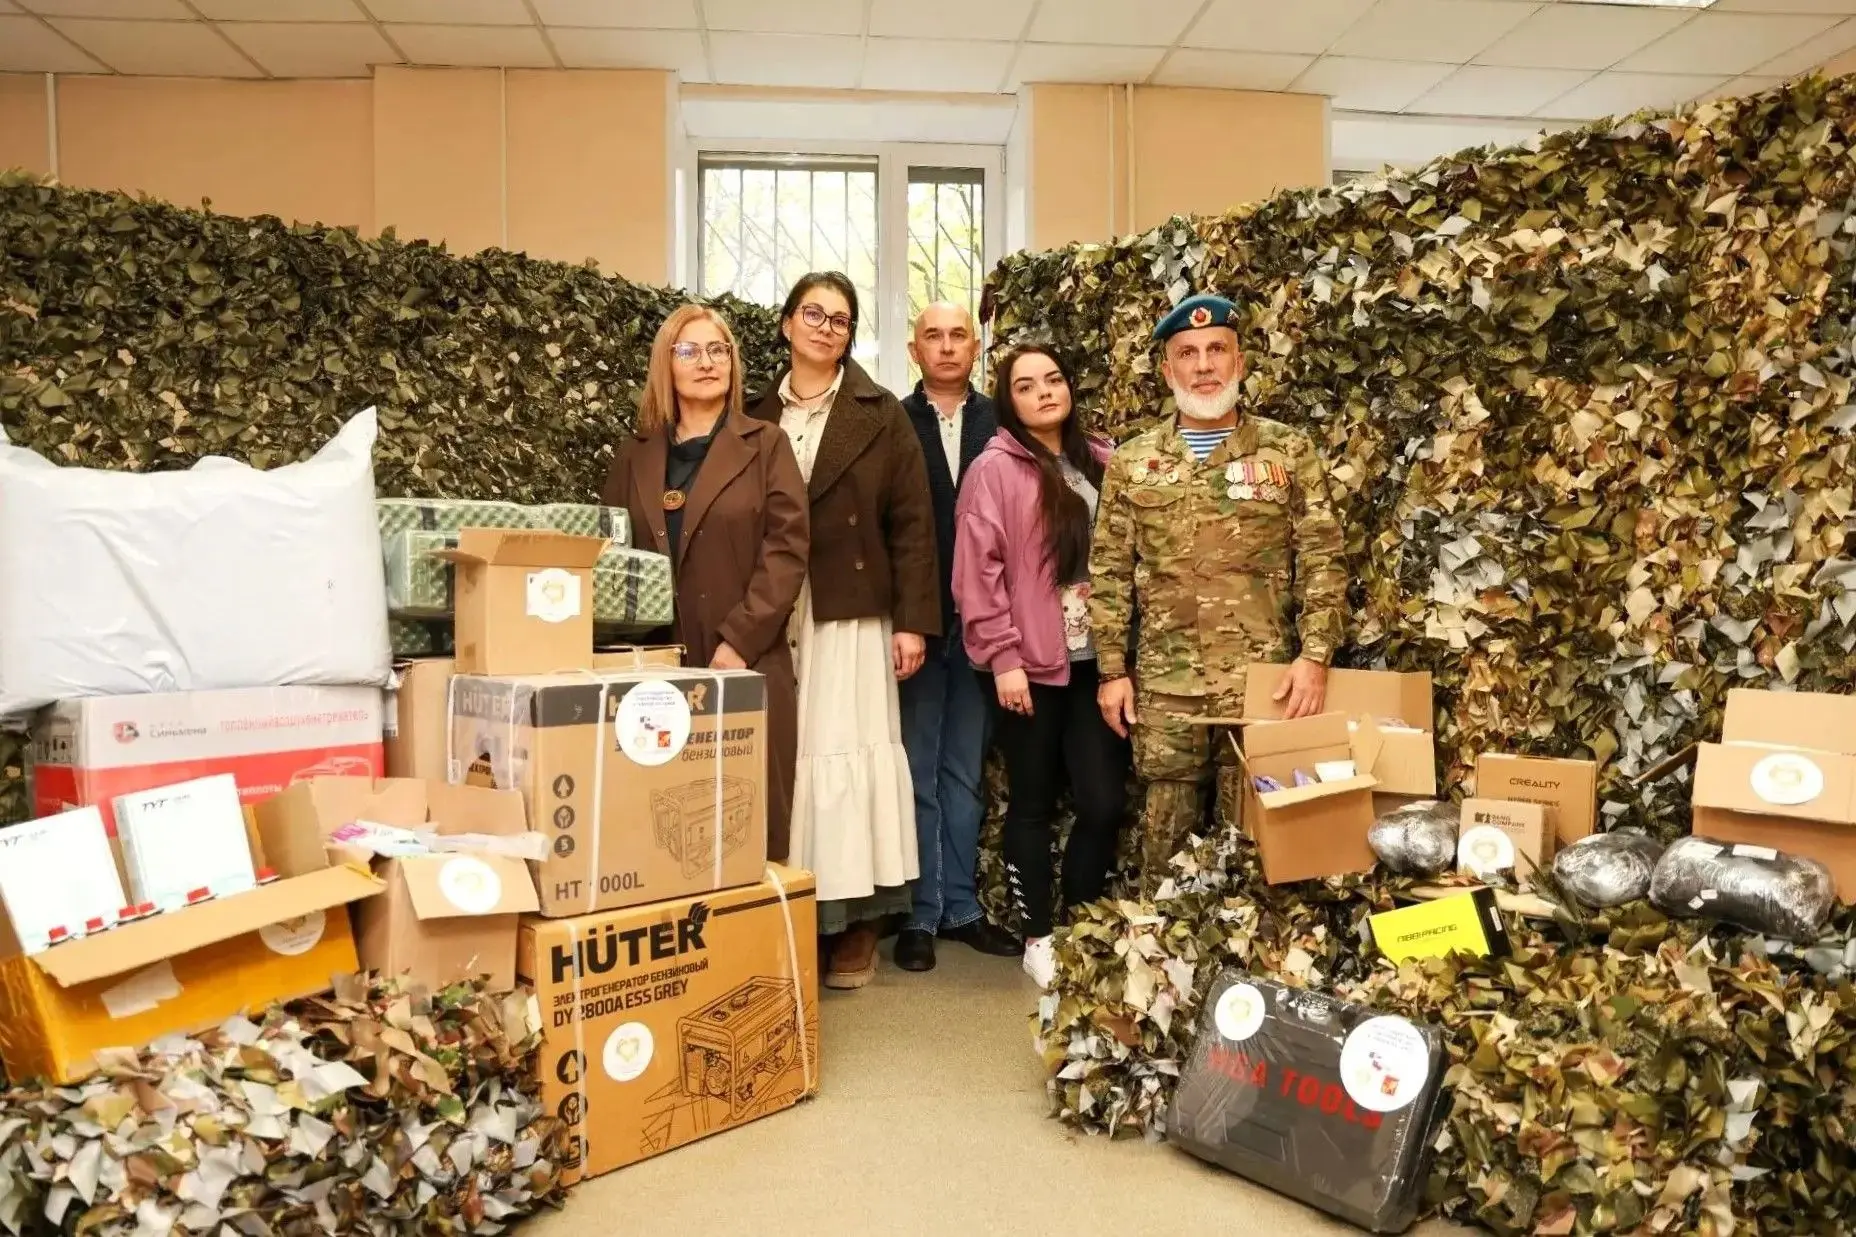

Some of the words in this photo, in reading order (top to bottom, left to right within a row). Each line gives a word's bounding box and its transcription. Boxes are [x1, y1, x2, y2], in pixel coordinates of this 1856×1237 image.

[682, 745, 753, 762] бензиовый
[1509, 777, 1560, 790] CREALITY
[555, 880, 583, 900] HT
[589, 871, 645, 894] 000L
[552, 903, 708, 984] HÜTER
[650, 957, 709, 983] БЕНЗИНОВЫЙ
[554, 1009, 574, 1028] DY
[625, 988, 652, 1010] ESS
[653, 978, 689, 1004] GREY
